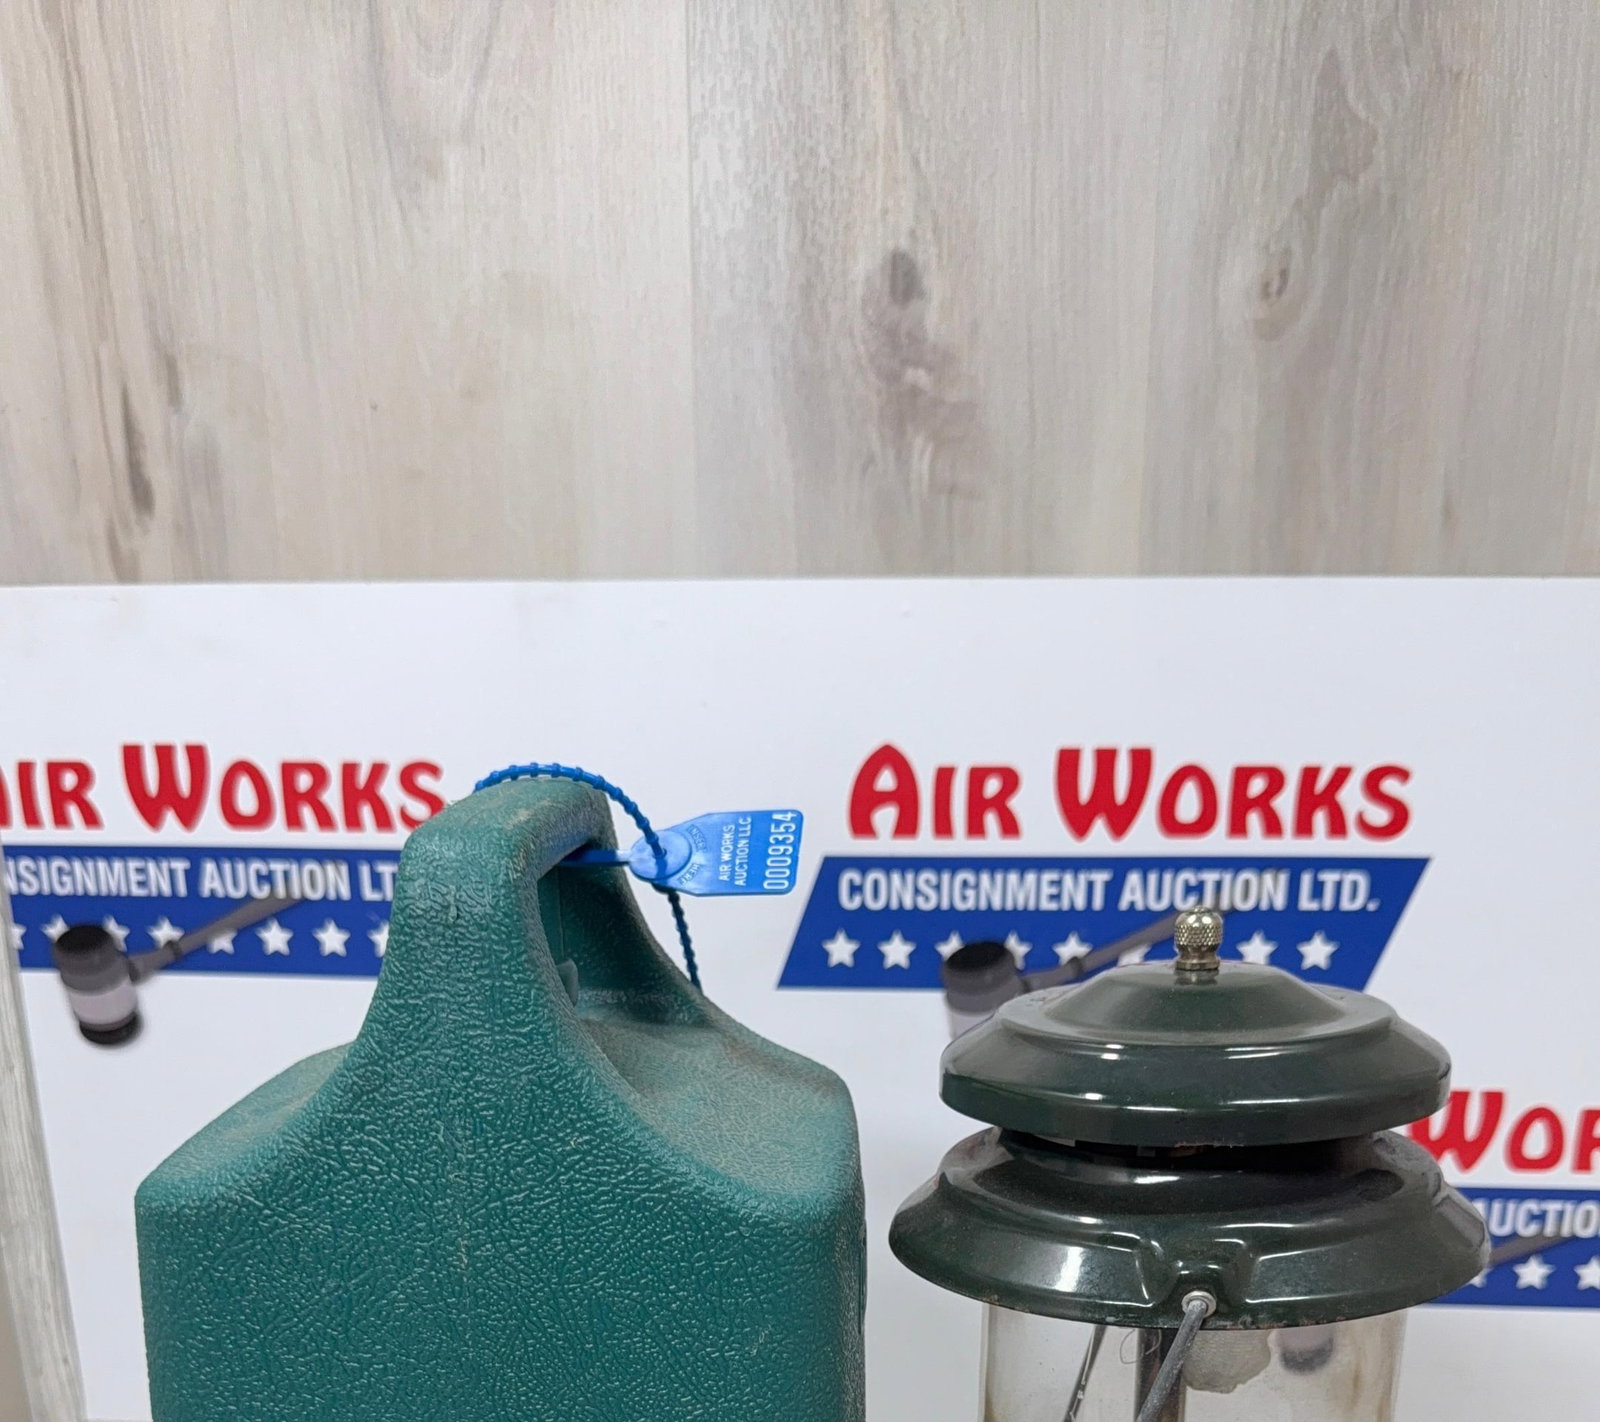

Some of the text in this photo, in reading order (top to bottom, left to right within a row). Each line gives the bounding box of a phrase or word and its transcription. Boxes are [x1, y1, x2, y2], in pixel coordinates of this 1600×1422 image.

[0, 743, 446, 834] IR WORKS
[847, 743, 1413, 841] AIR WORKS
[201, 858, 350, 901] AUCTION
[718, 823, 736, 882] AIR WORKS
[734, 815, 752, 887] AUCTION LLC
[762, 811, 797, 890] 0009354
[838, 868, 1381, 912] CONSIGNMENT AUCTION LTD.
[1472, 1198, 1600, 1239] UCTIO
